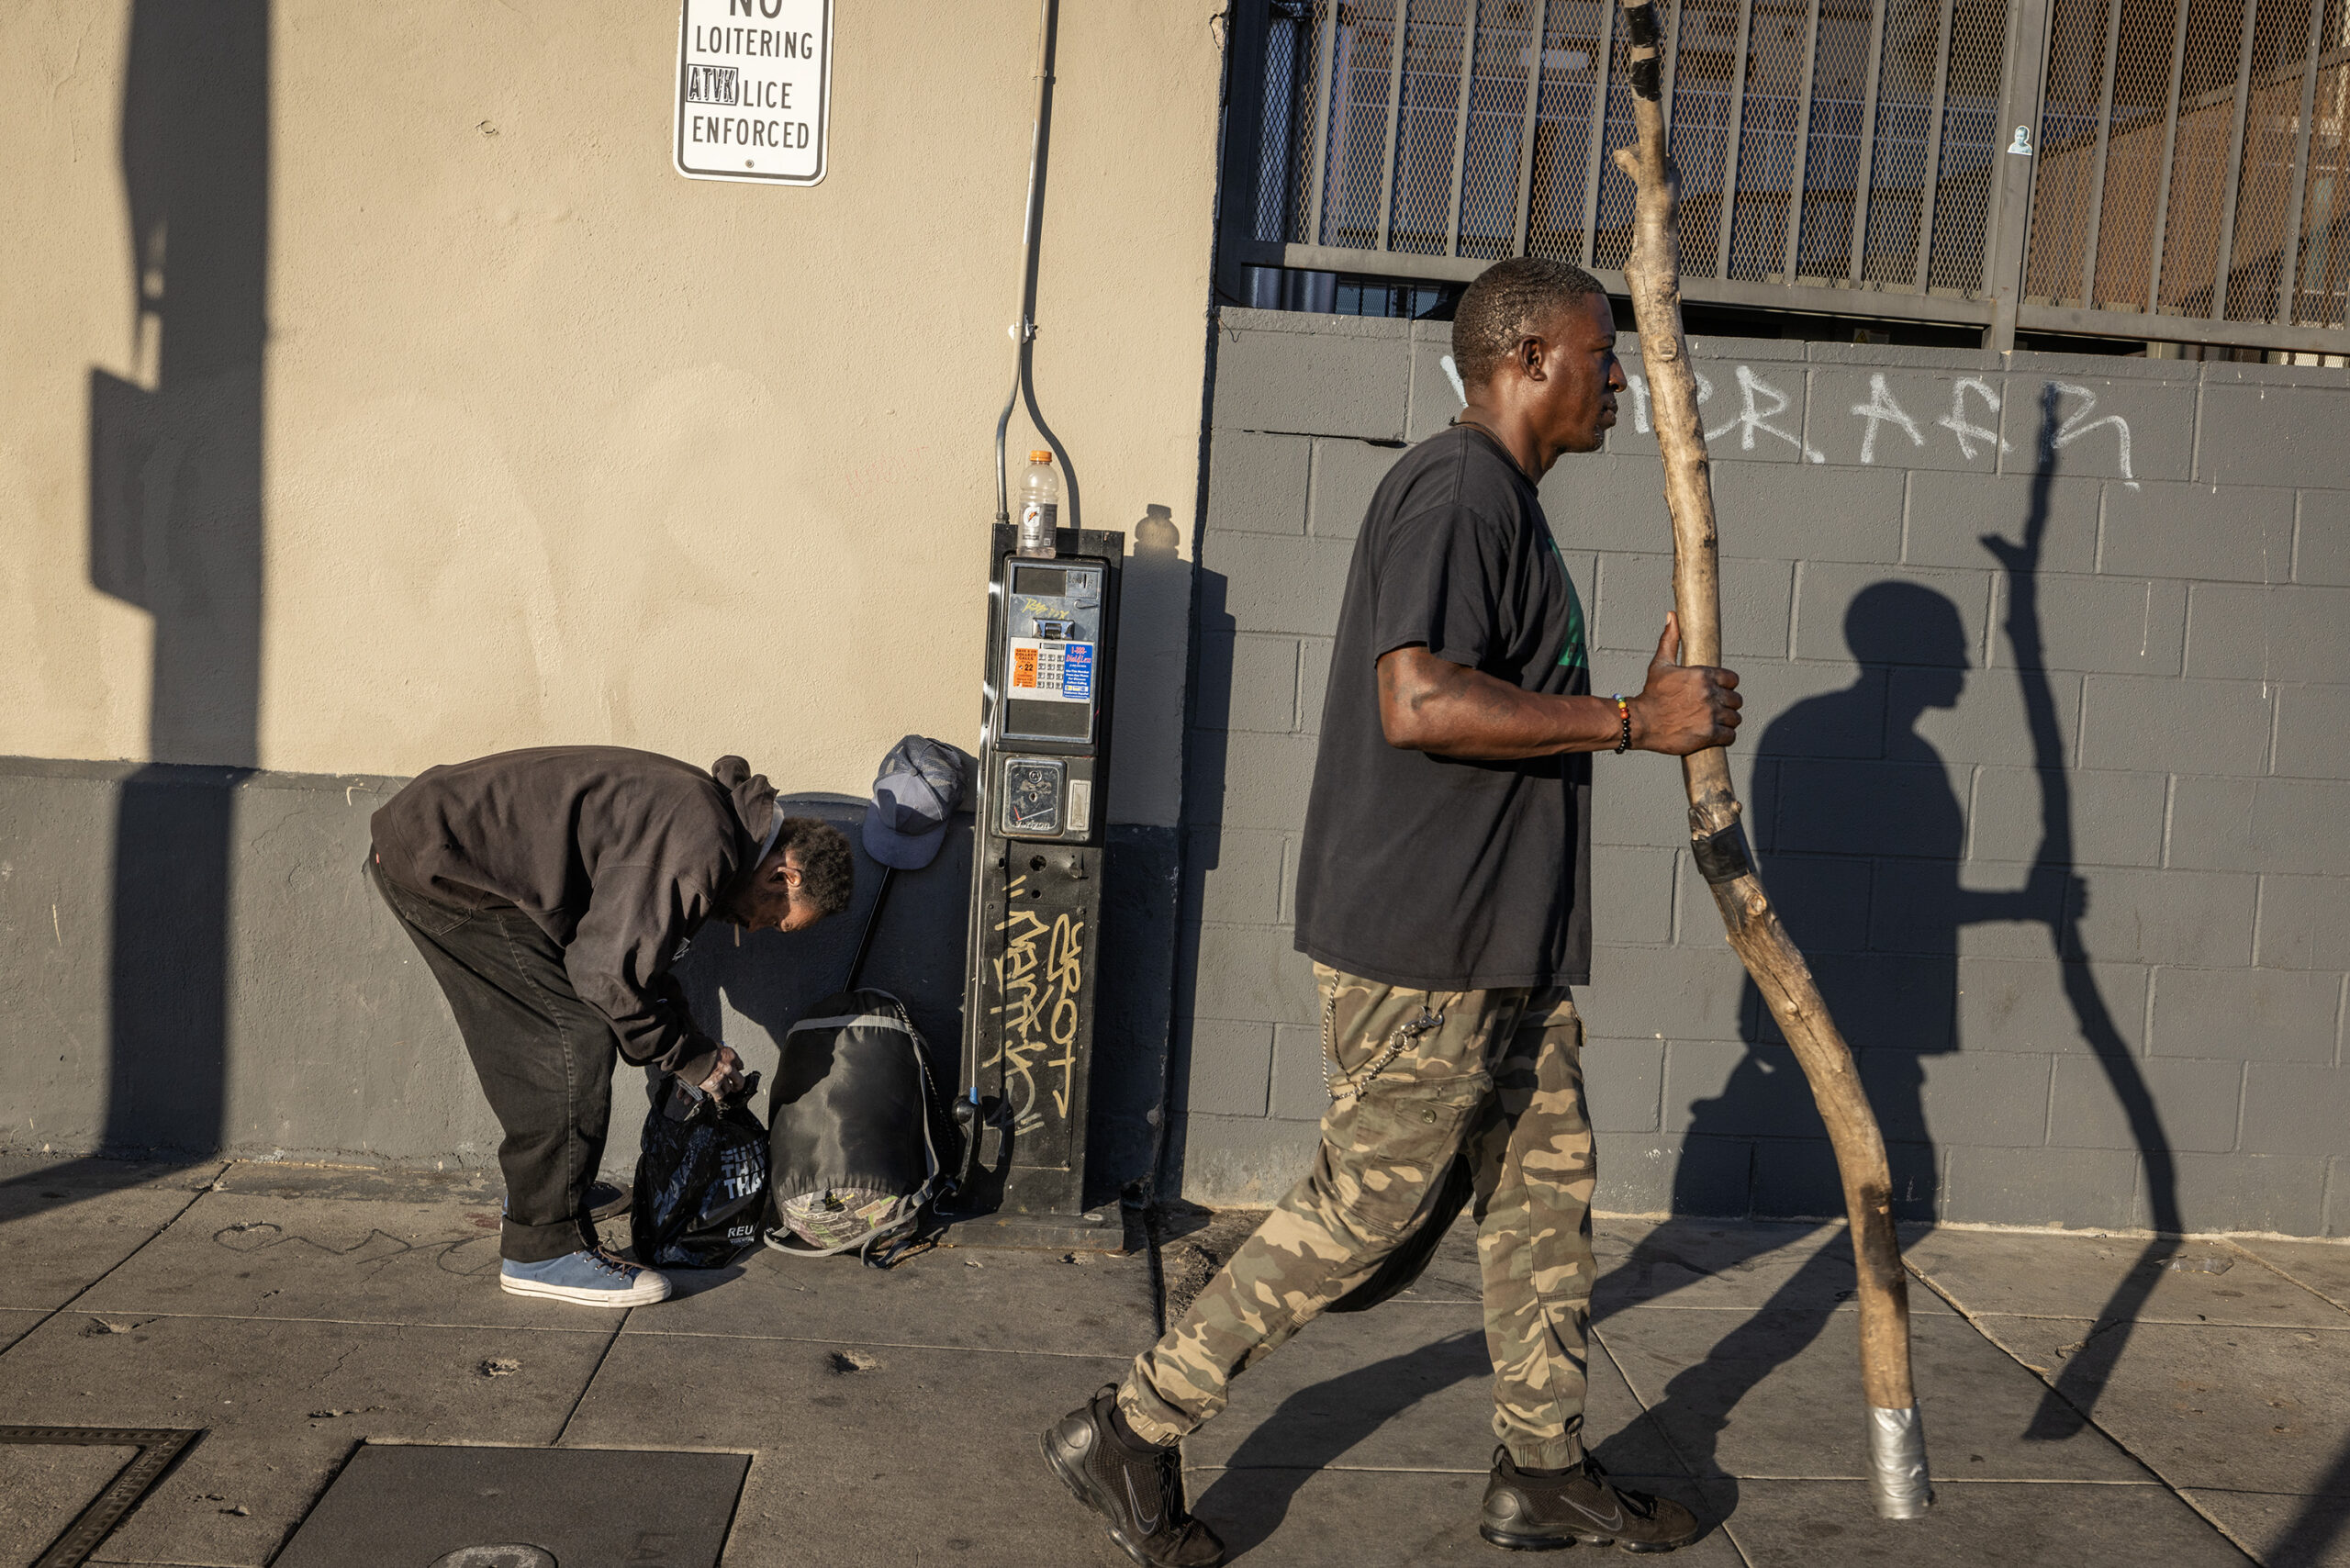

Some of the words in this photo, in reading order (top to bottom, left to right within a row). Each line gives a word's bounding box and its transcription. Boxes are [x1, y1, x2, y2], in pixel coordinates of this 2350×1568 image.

[696, 26, 813, 60] LOITERING
[736, 80, 793, 109] LICE
[692, 116, 810, 149] ENFORCED
